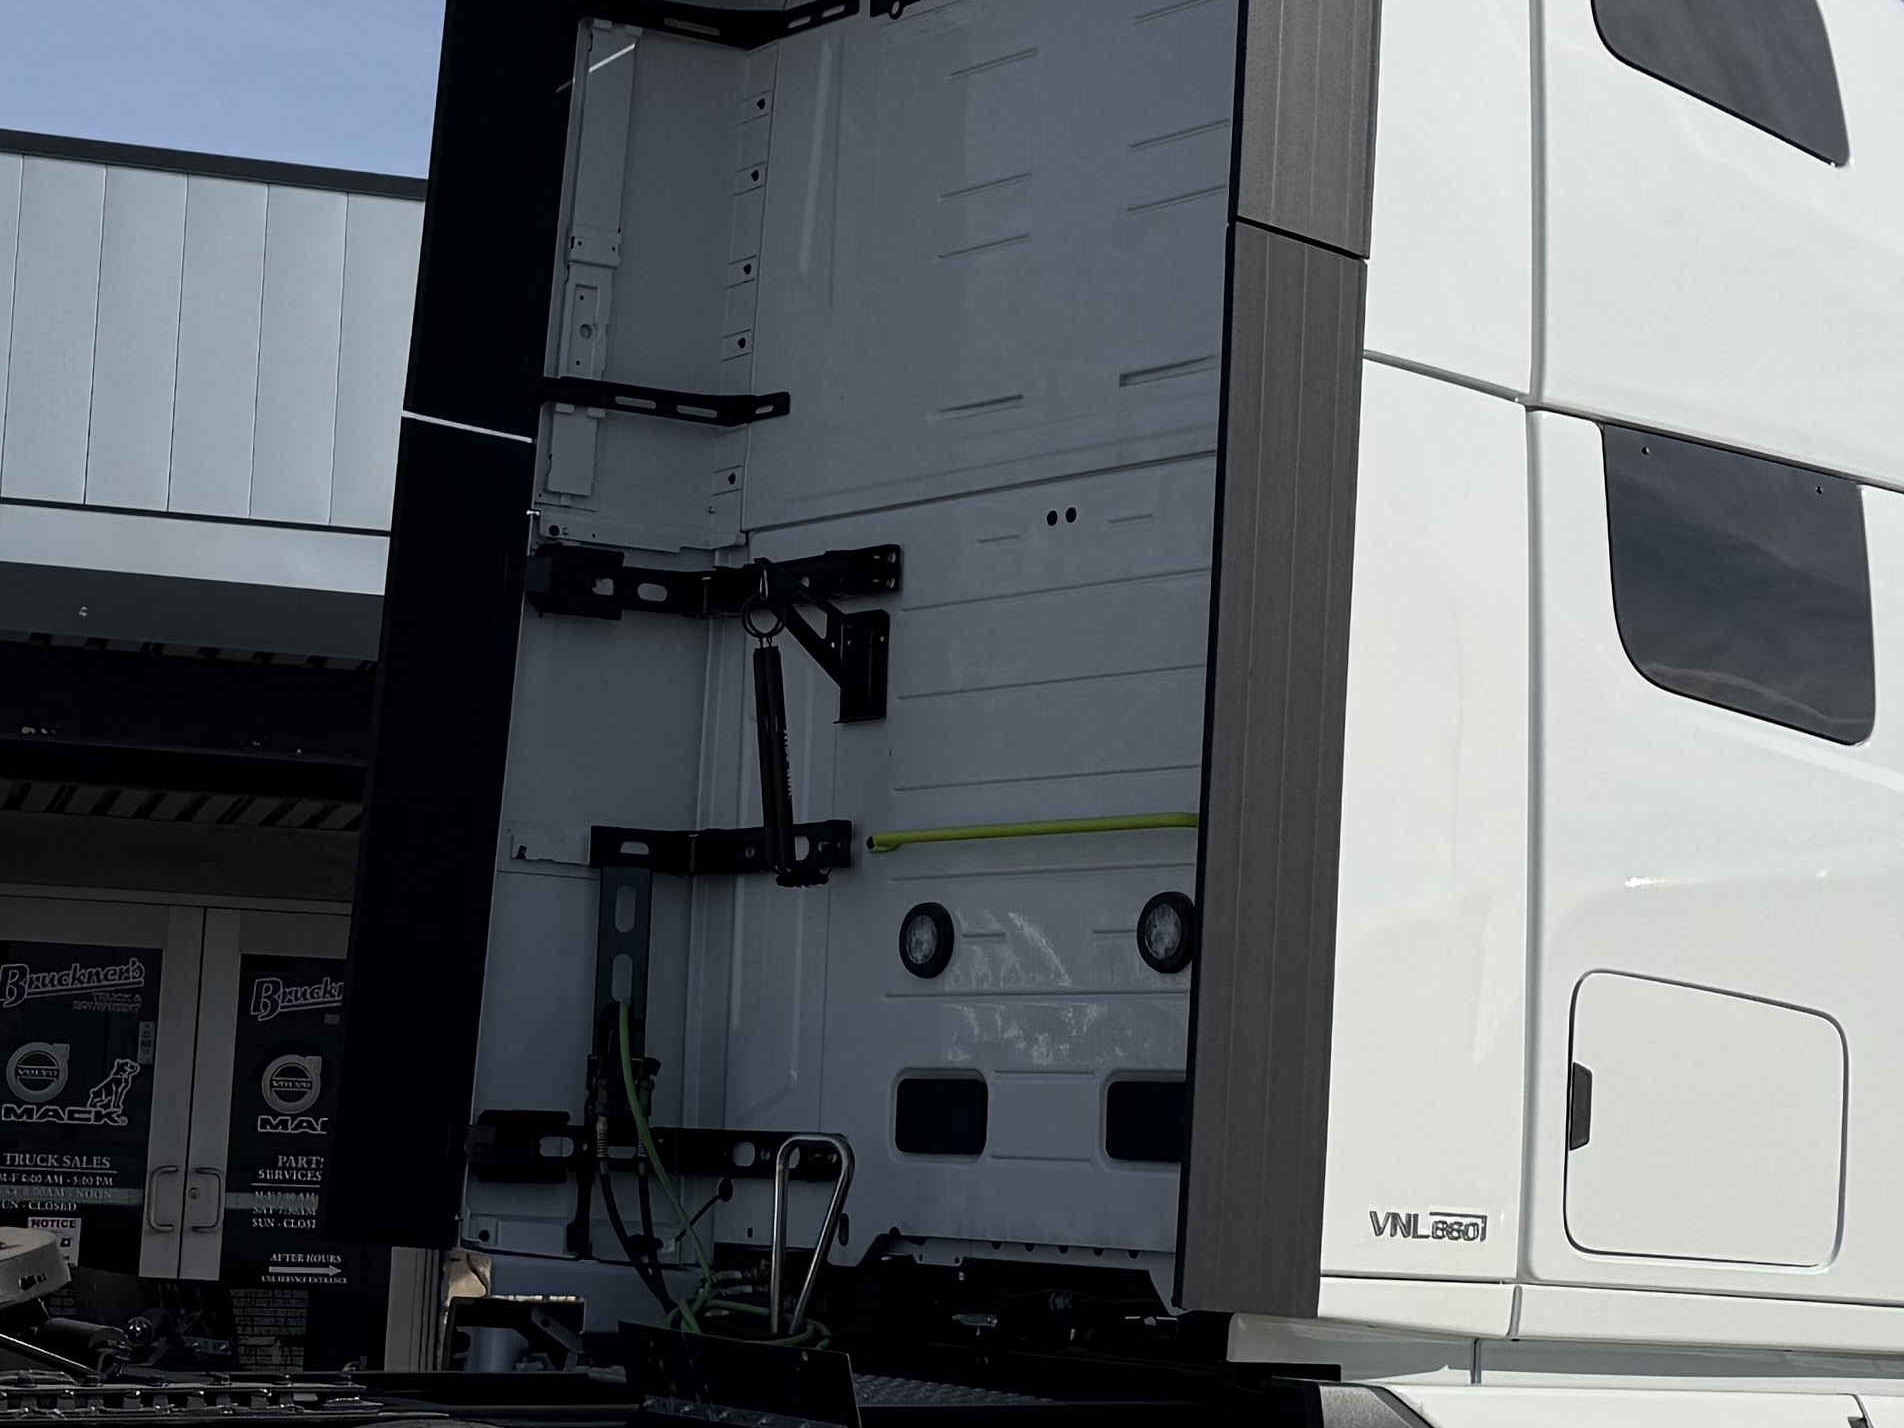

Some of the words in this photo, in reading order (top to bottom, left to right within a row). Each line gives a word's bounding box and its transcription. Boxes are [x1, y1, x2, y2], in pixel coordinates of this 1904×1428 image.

[17, 1068, 57, 1077] VOLVO
[272, 1080, 311, 1089] VOLVO
[1, 1103, 123, 1126] MACK
[2, 1152, 58, 1167] TRUCK
[61, 1155, 112, 1169] SALES
[28, 1201, 78, 1212] CLOSED
[31, 1219, 76, 1229] NOTICE
[270, 1253, 304, 1262] AFTER
[306, 1254, 342, 1263] HOURS
